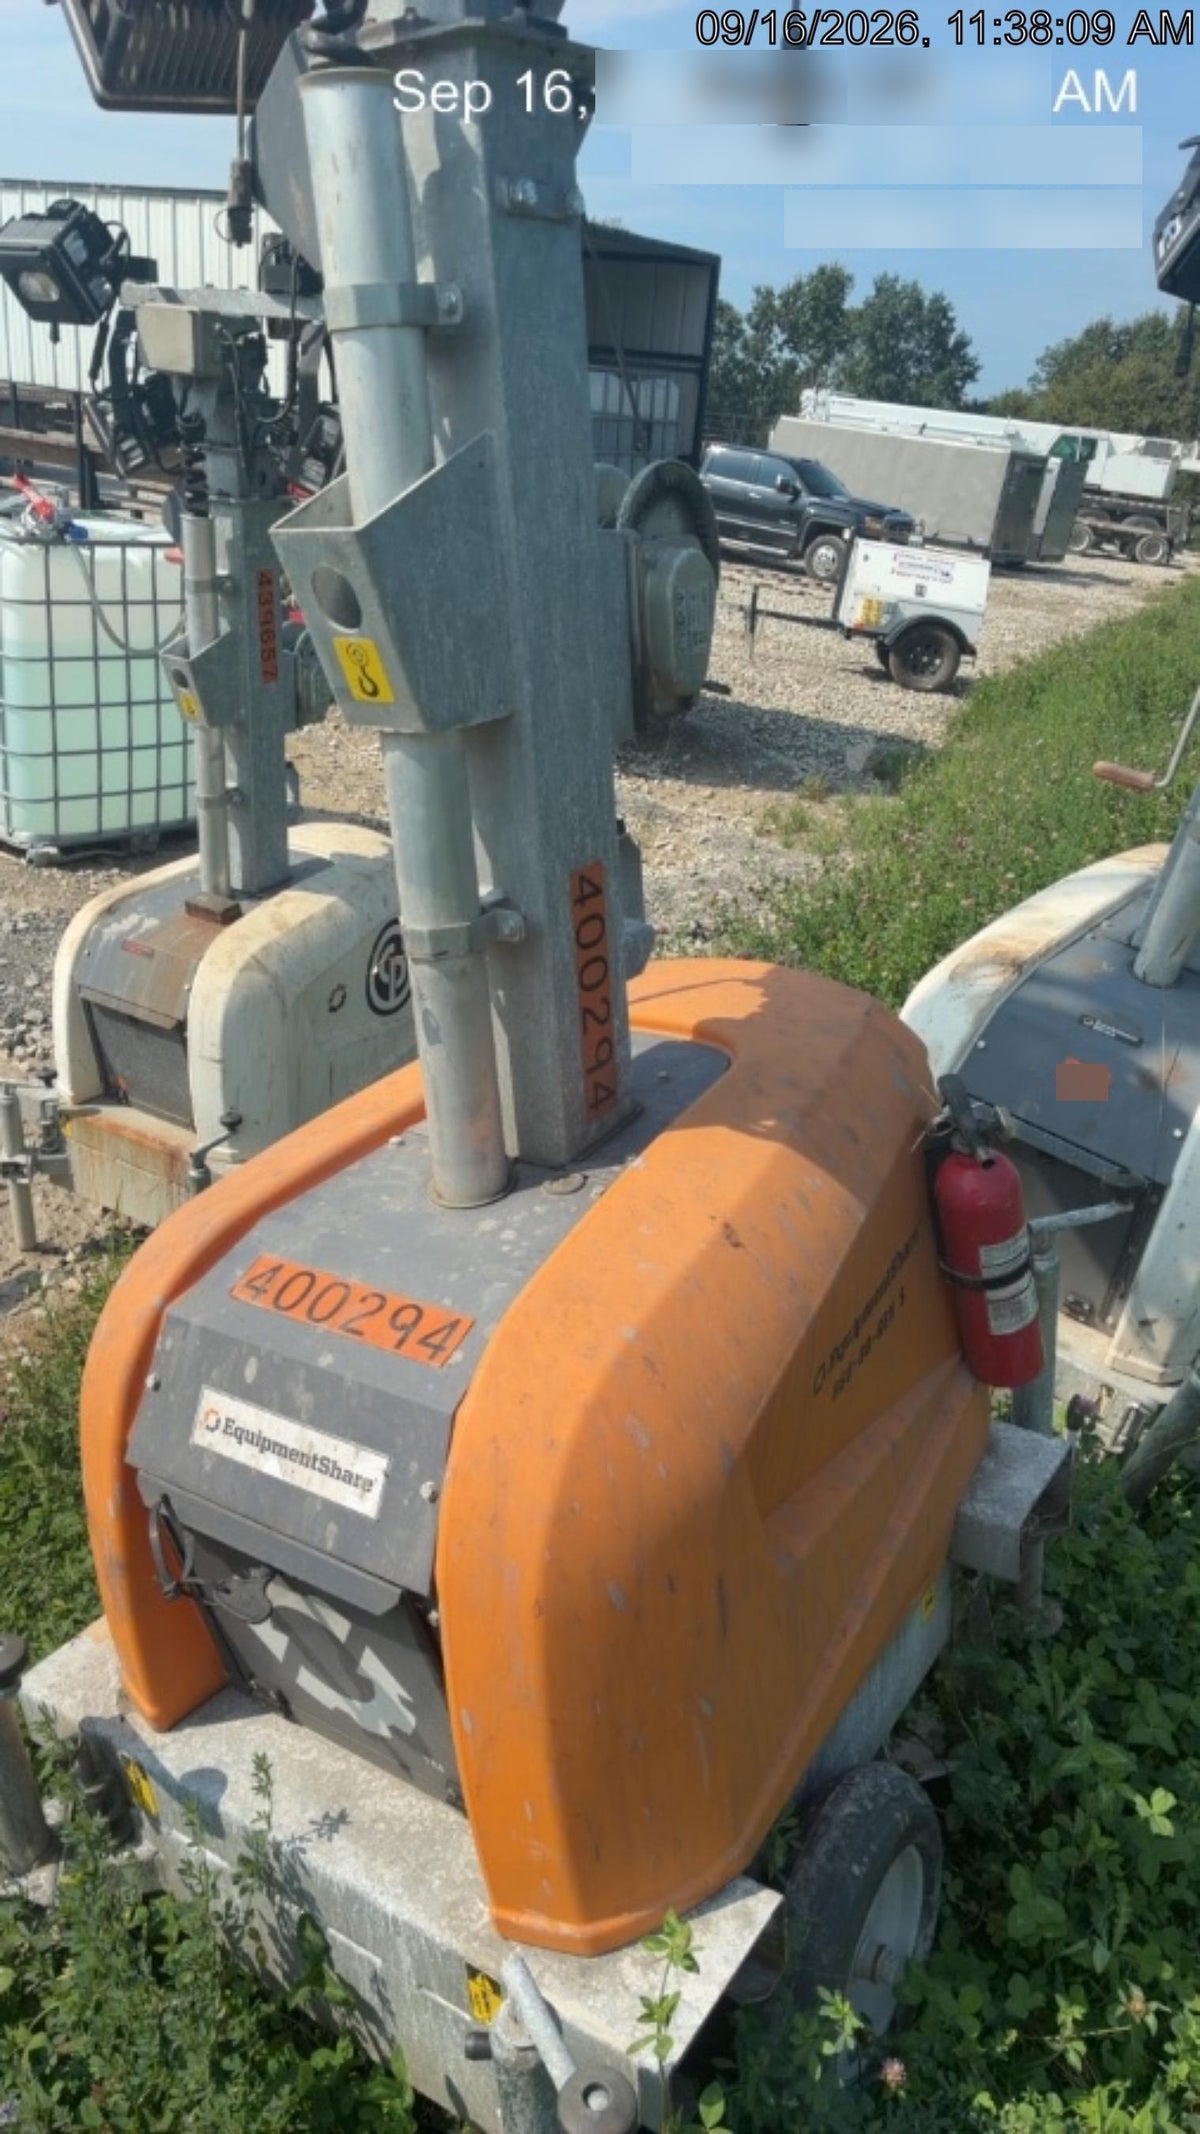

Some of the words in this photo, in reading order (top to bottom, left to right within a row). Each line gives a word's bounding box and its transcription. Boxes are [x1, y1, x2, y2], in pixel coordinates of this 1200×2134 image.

[572, 874, 616, 1111] 400294
[243, 1263, 463, 1361] 400294
[222, 1417, 374, 1493] EquipmentShare
